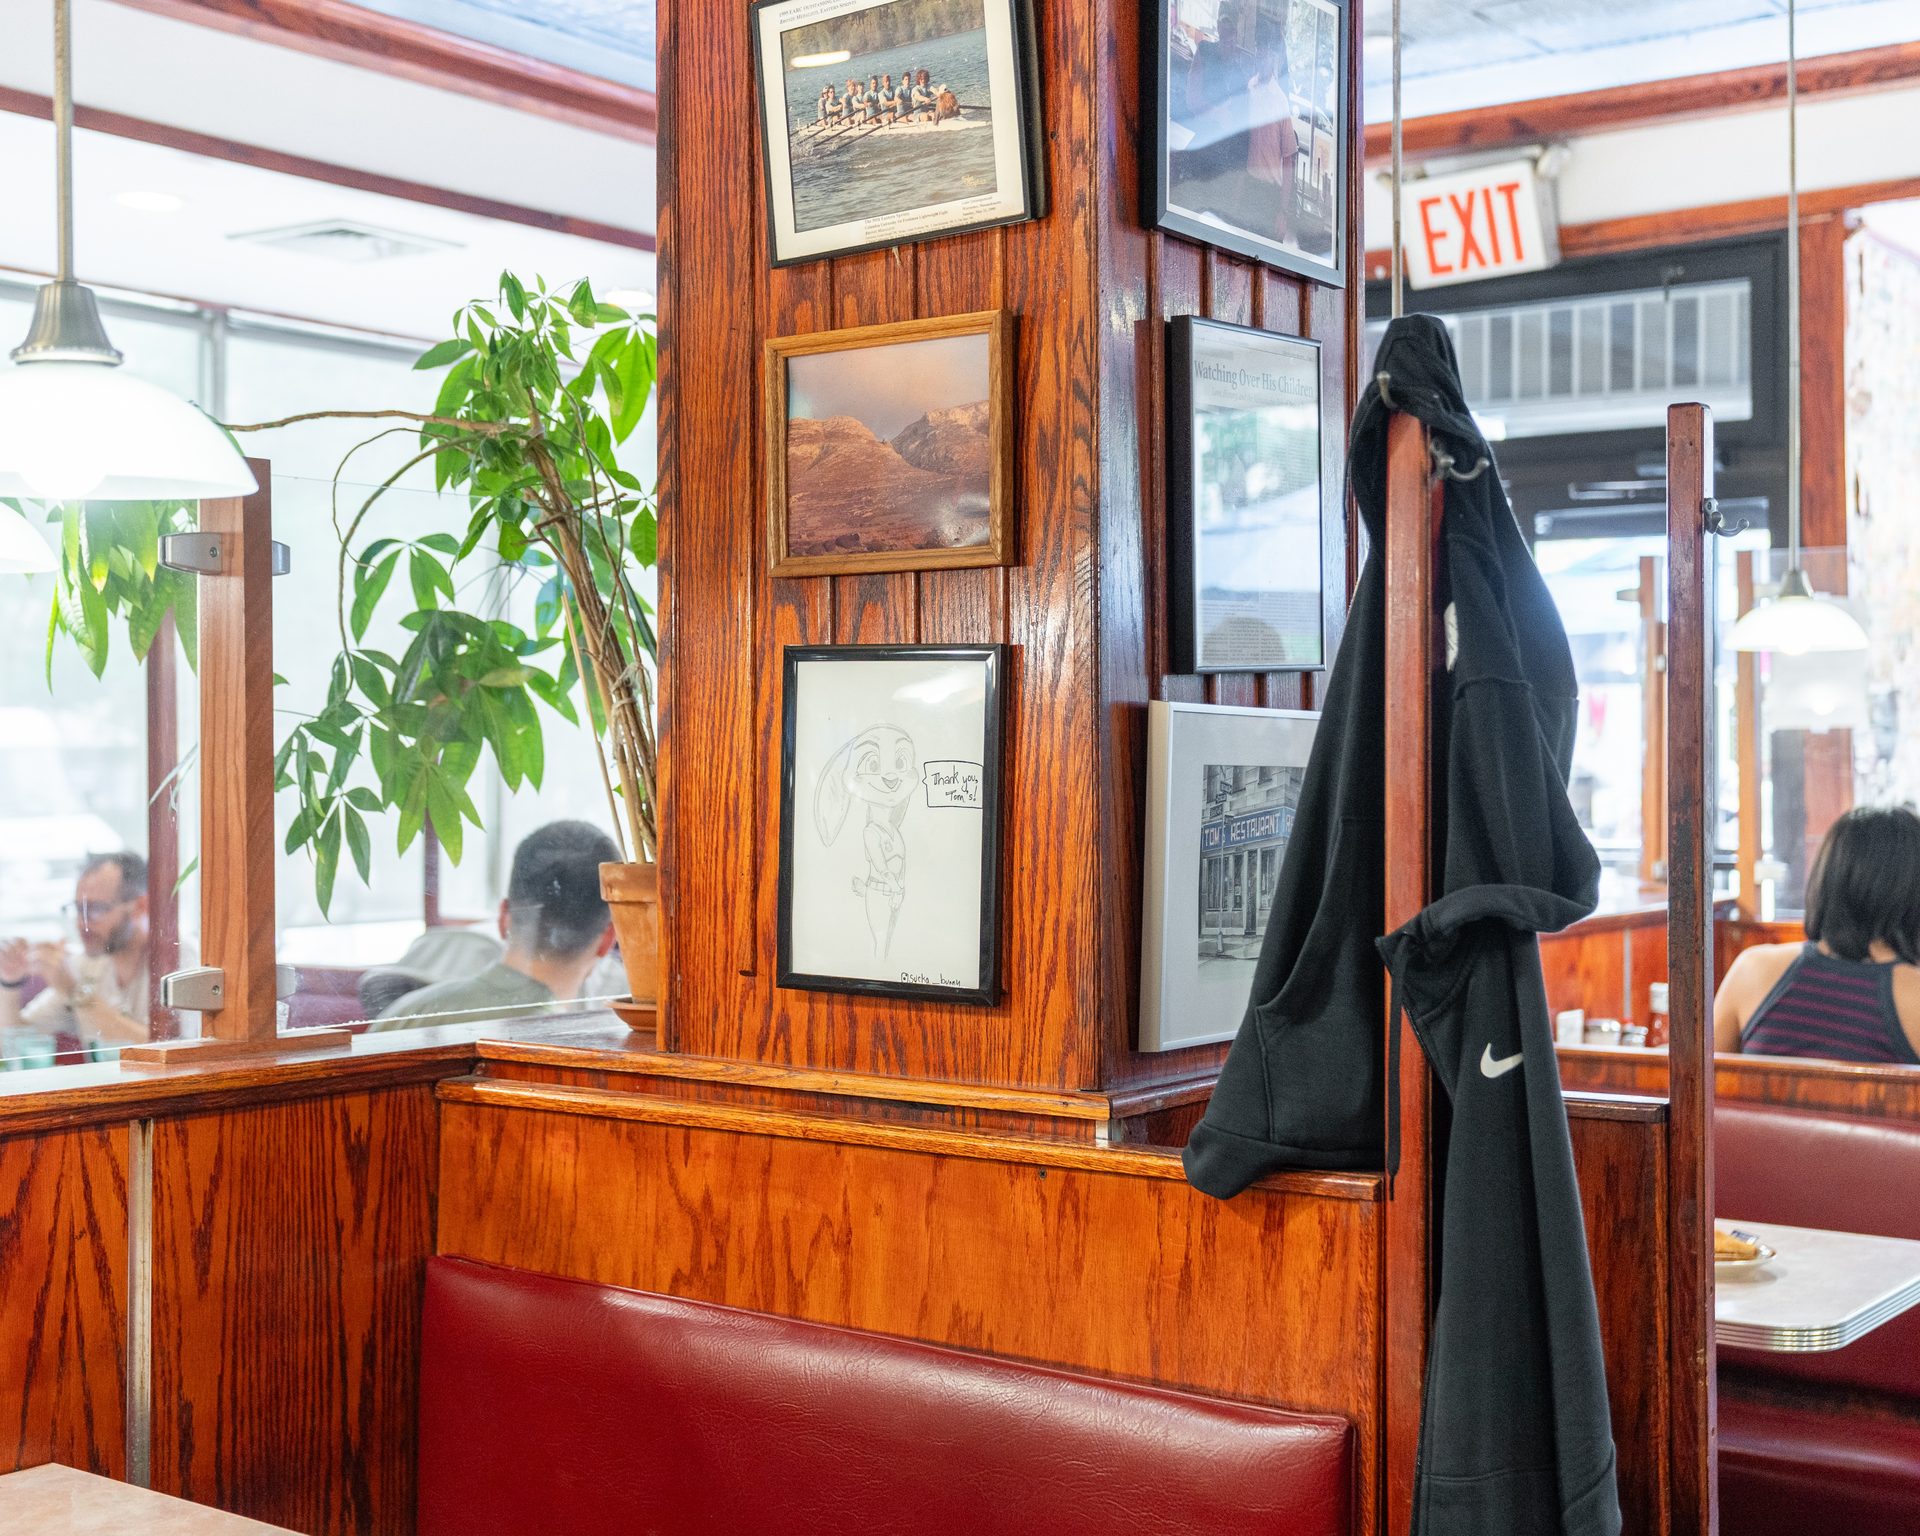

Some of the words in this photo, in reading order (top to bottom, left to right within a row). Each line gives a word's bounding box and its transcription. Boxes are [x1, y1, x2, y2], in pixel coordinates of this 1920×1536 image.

[1419, 181, 1524, 275] EXIT
[1194, 359, 1238, 390] Watching
[1239, 368, 1261, 388] Over
[1261, 372, 1277, 392] His
[1278, 374, 1314, 398] Children
[931, 764, 960, 786] Thank
[961, 774, 979, 793] you,
[1230, 812, 1281, 843] RESTAURANT
